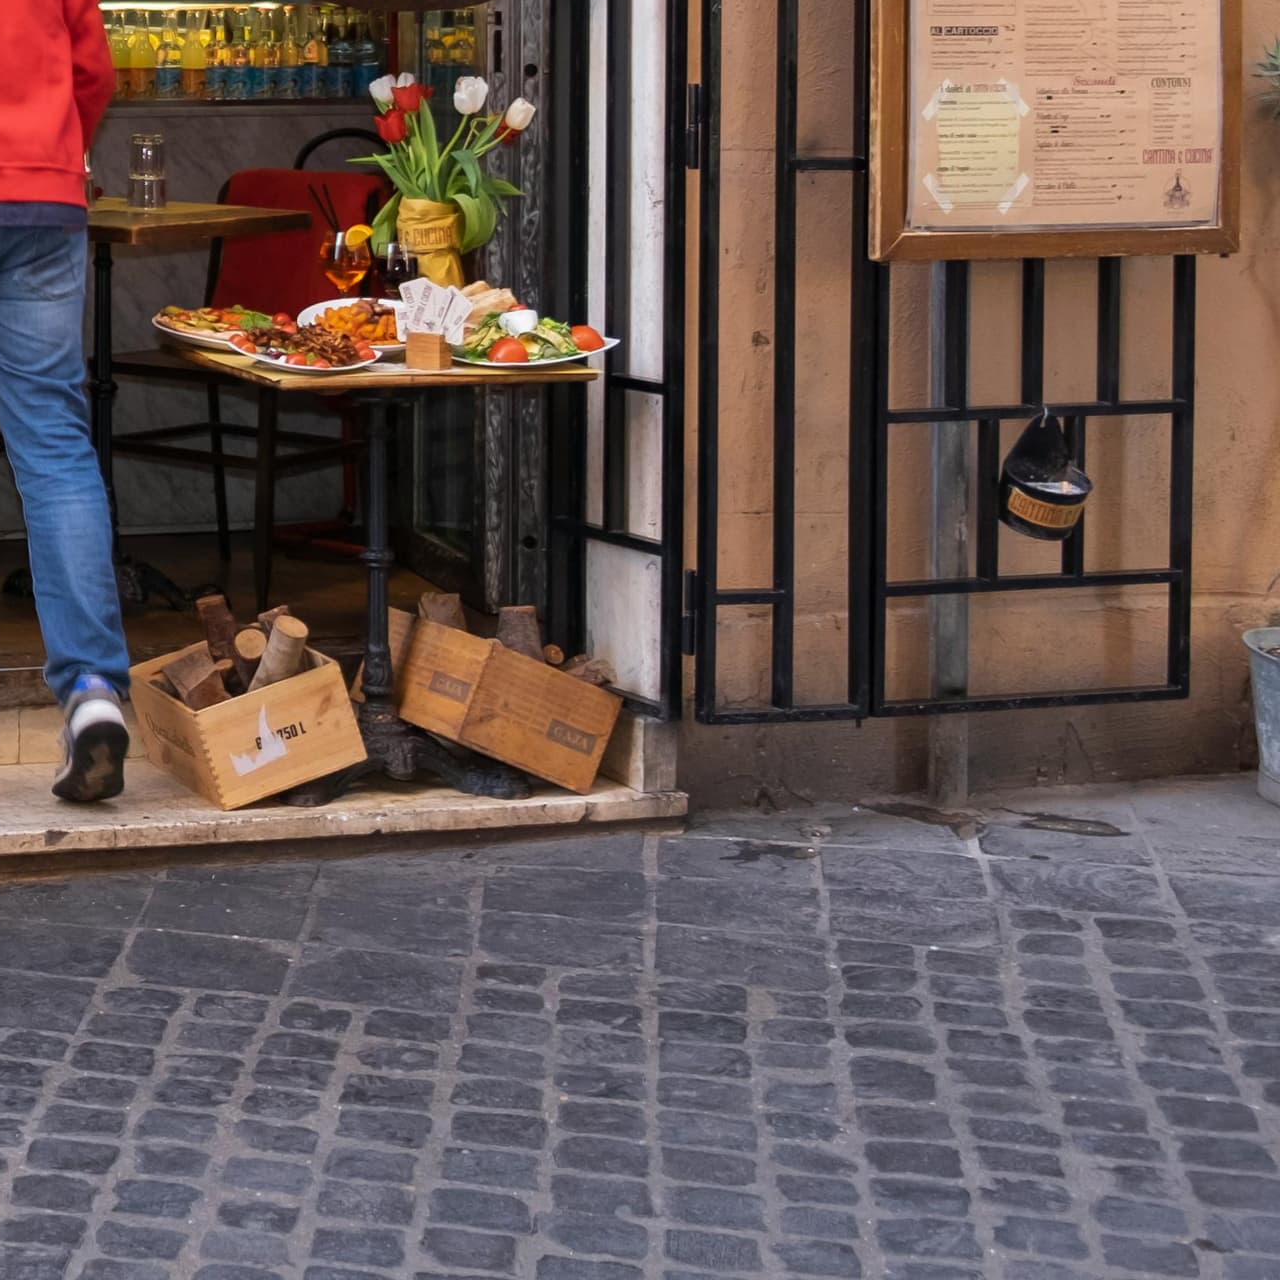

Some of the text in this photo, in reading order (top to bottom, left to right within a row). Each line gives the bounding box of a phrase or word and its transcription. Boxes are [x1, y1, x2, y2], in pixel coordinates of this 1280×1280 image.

[1142, 148, 1176, 164] CANTINA
[1184, 148, 1214, 164] CUCINA
[299, 721, 307, 735] L
